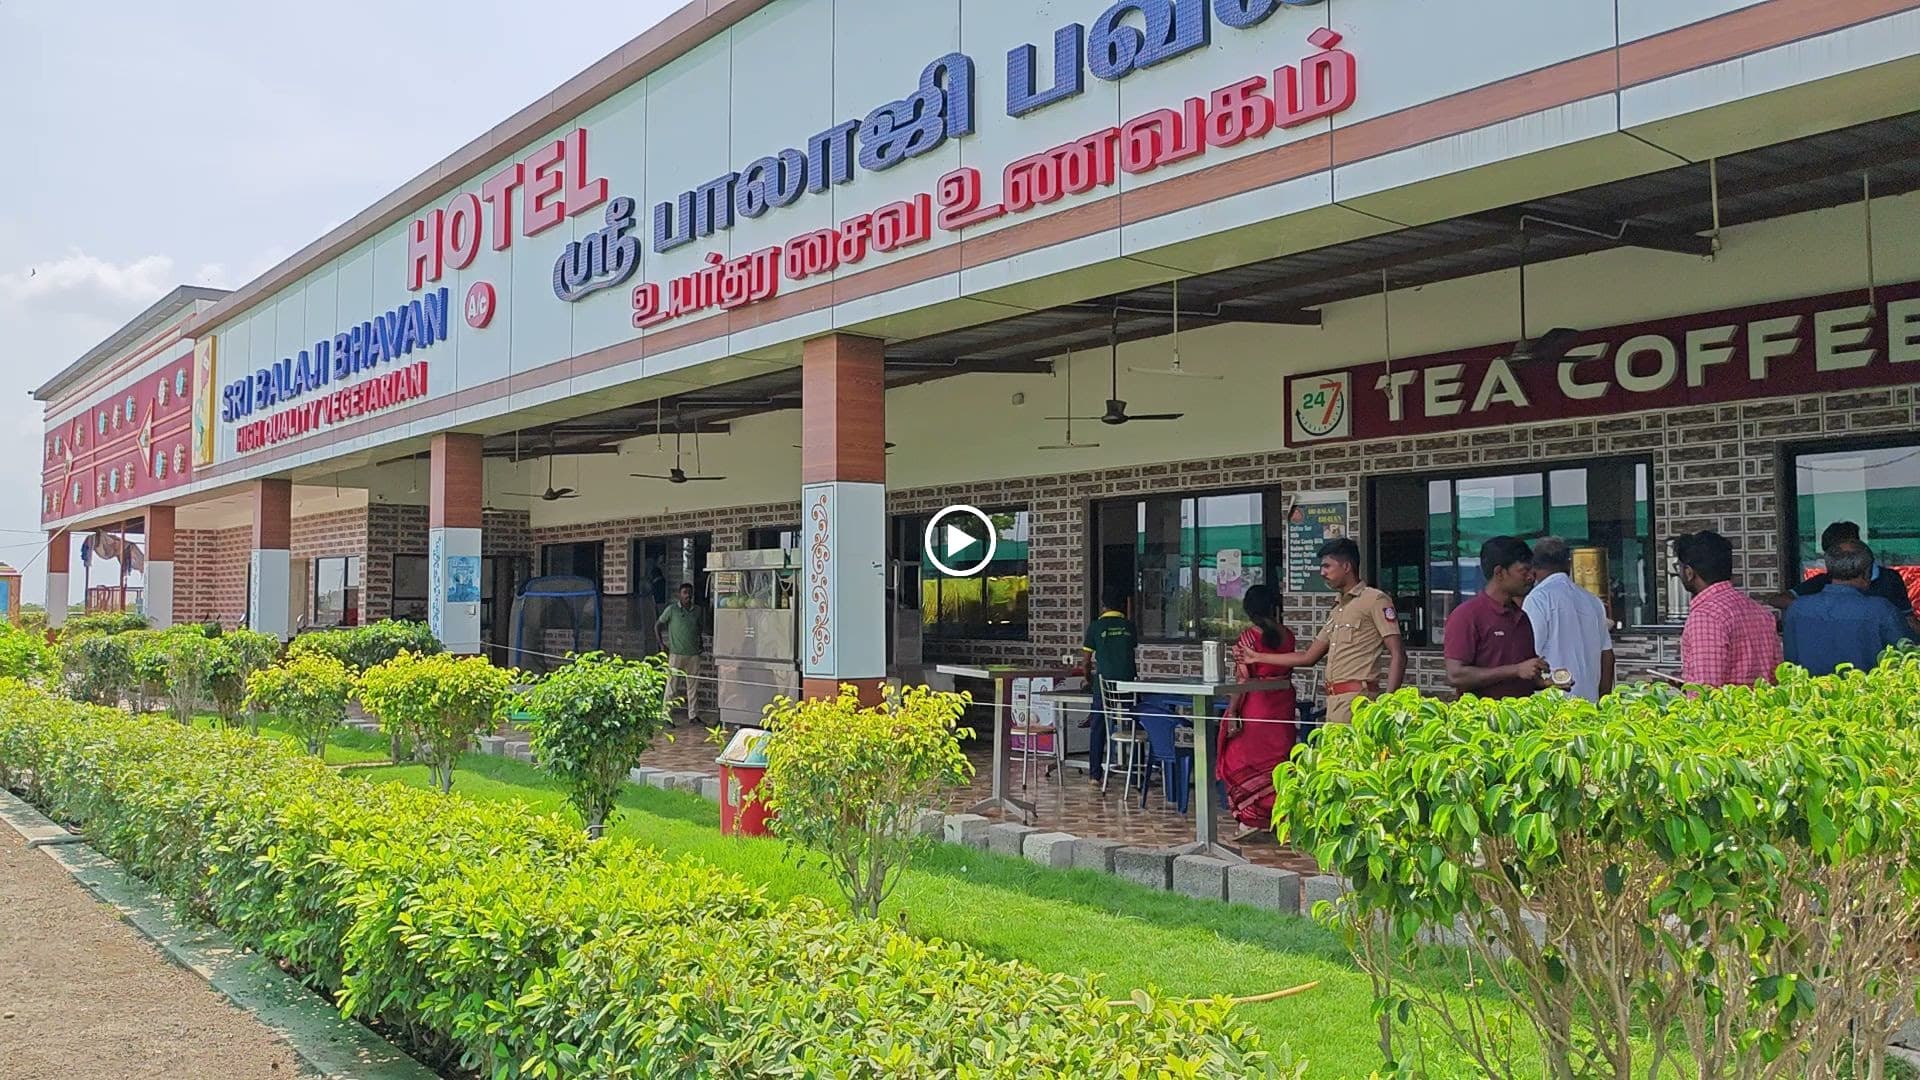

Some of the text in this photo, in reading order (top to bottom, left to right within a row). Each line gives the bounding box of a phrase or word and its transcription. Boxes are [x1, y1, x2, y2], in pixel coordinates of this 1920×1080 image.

[407, 128, 608, 291] HOTEL
[632, 27, 1356, 329] உயர்தர சைவ உணவகம்
[654, 52, 976, 254] பாலாஜி
[222, 287, 449, 423] SRI BALAJI BHAVAN
[236, 361, 428, 453] HIGH QUALITY VEGETARIAN
[1303, 382, 1343, 425] 24 7
[1374, 356, 1531, 422] TEA
